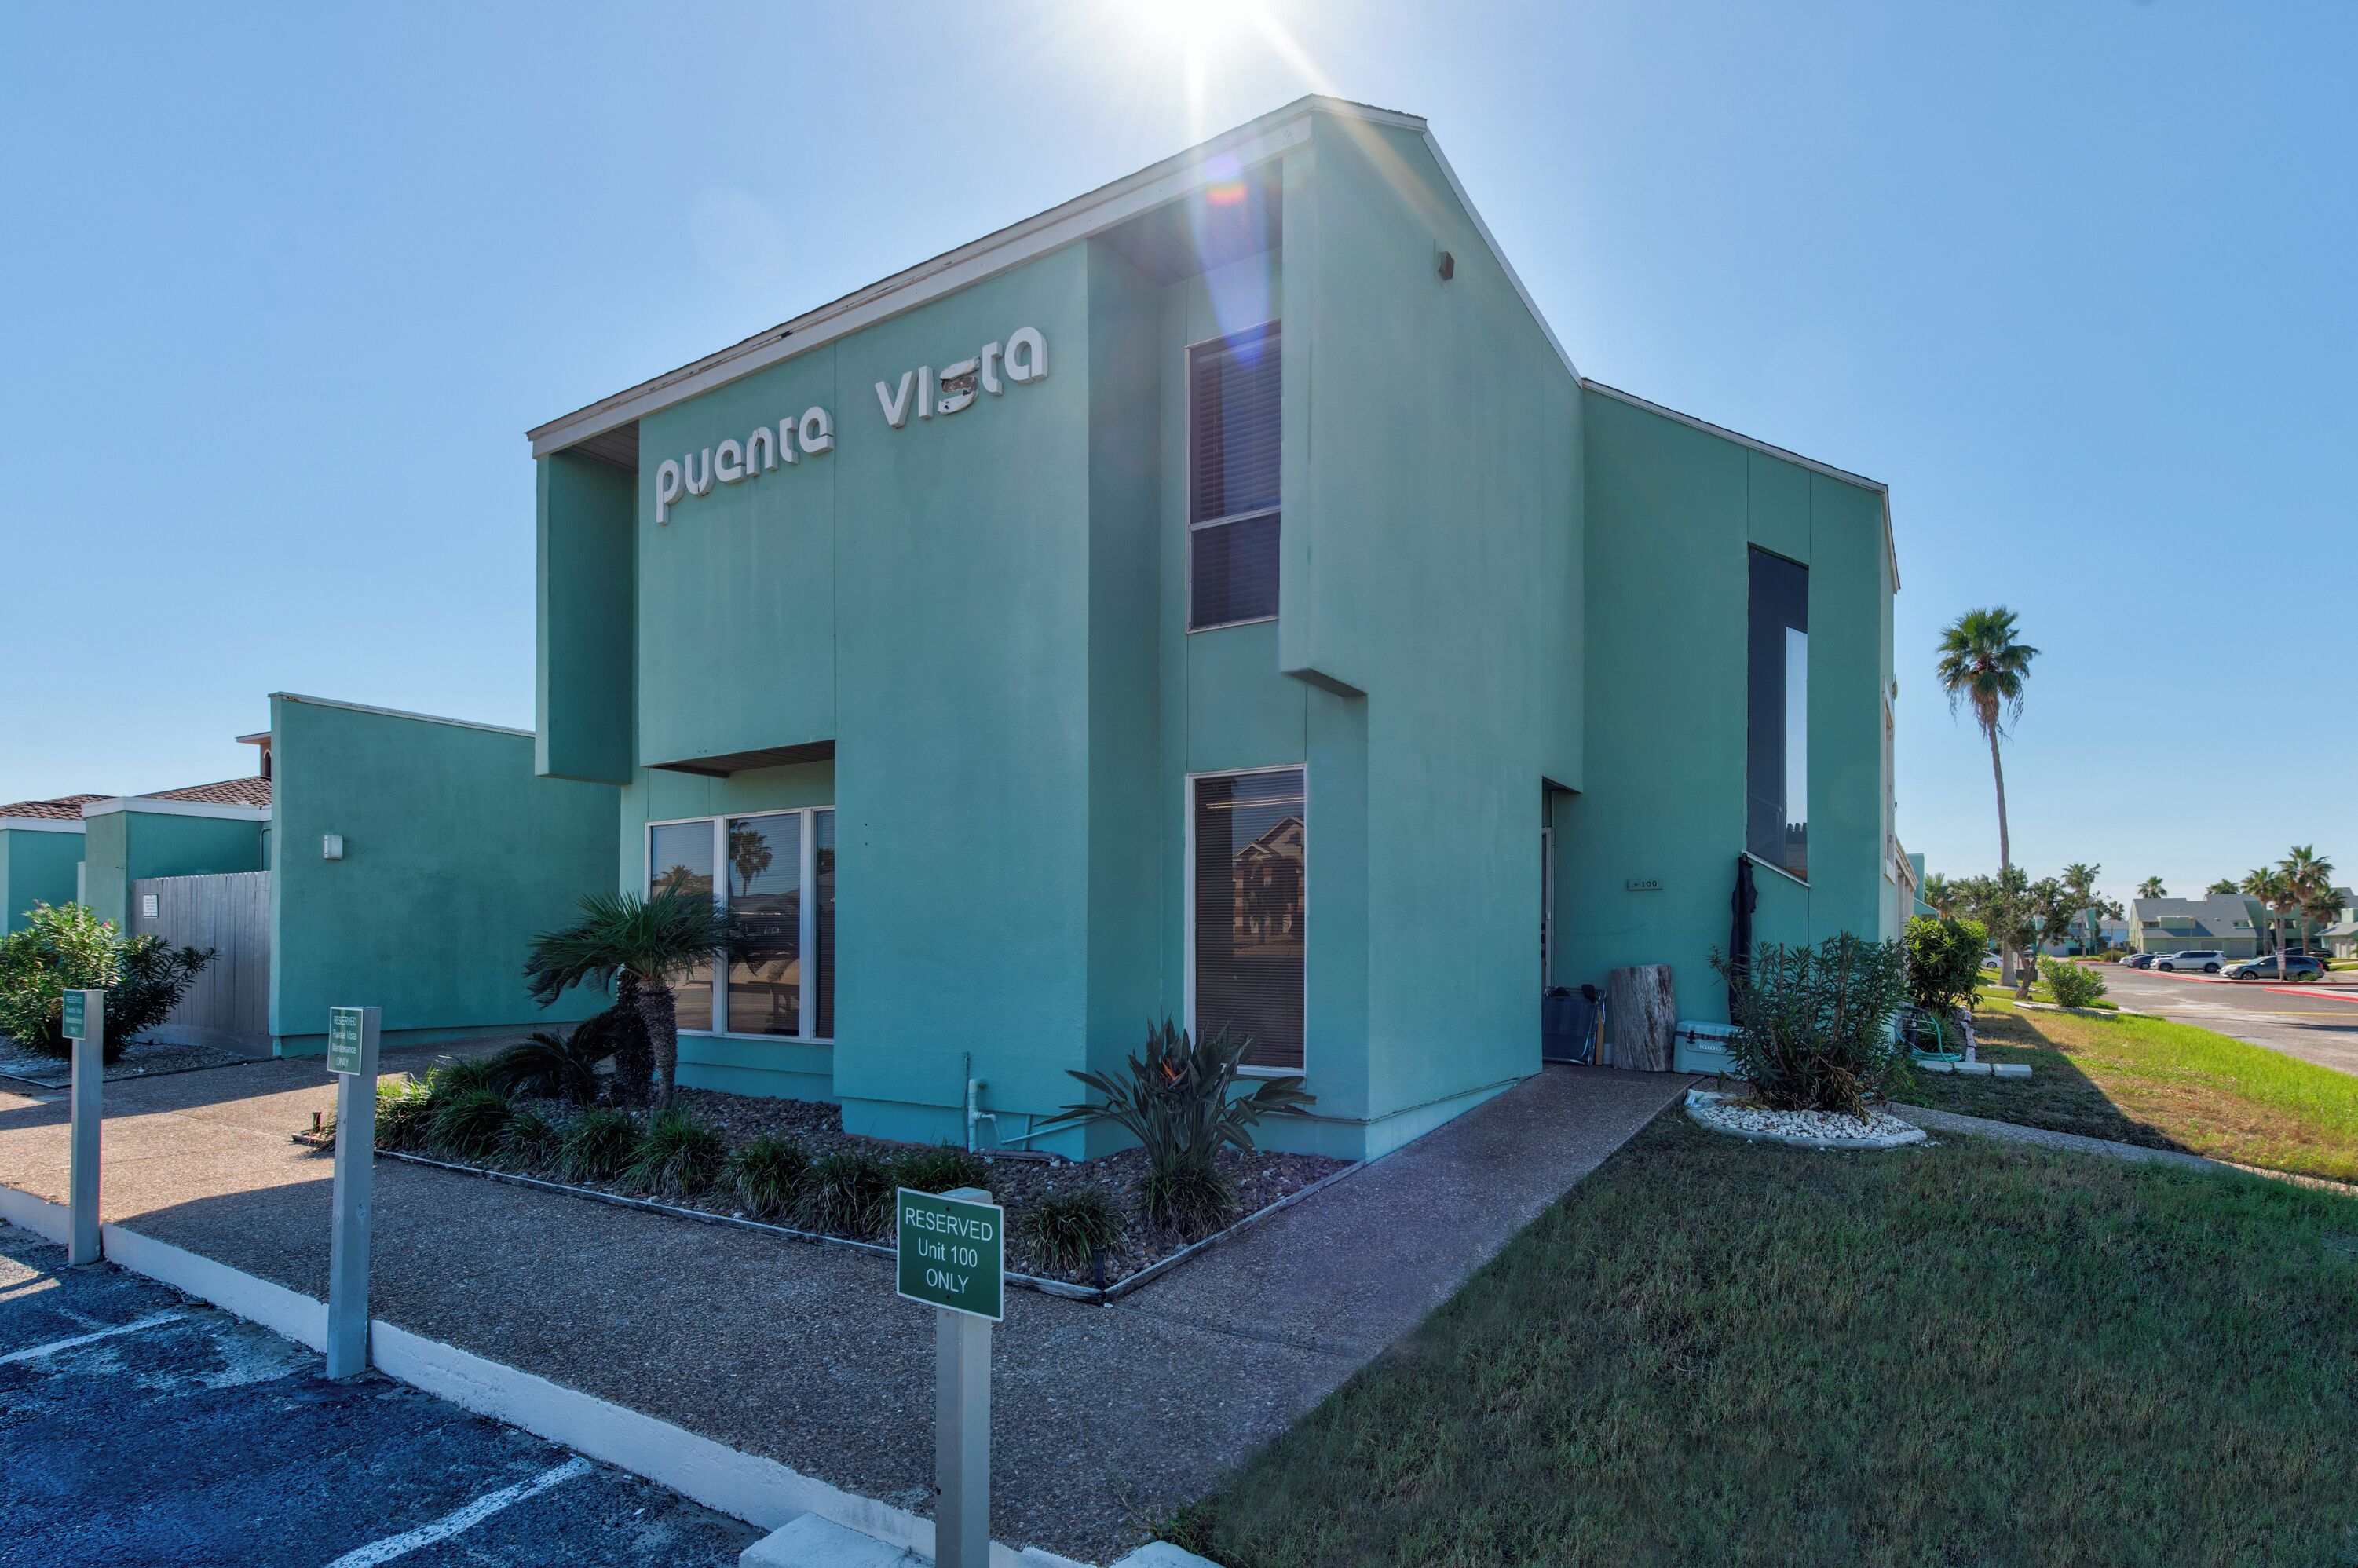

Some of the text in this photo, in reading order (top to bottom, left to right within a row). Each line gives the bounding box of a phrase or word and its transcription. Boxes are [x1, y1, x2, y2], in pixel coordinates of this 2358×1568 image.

[334, 1015, 357, 1026] RESERVED
[336, 1057, 349, 1067] ONLY
[905, 1207, 993, 1241] RESERVED
[918, 1237, 978, 1267] Unit 100
[926, 1268, 969, 1294] ONLY
